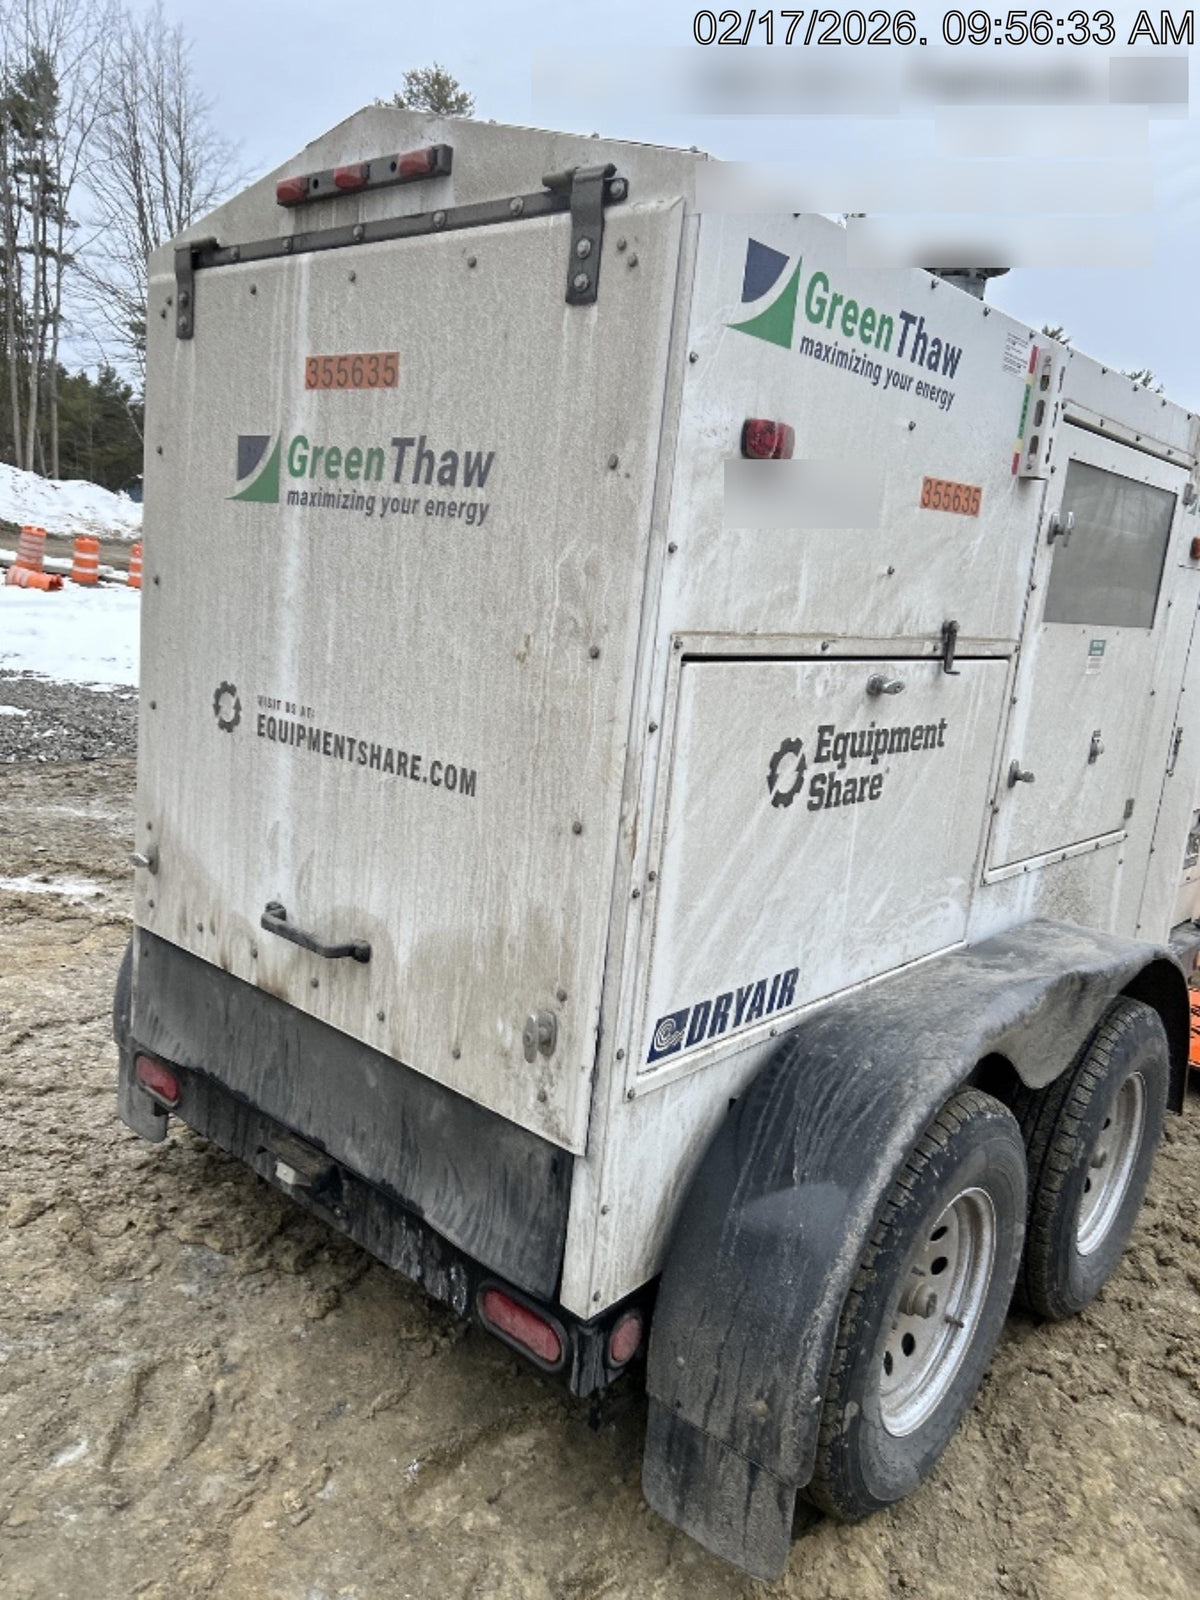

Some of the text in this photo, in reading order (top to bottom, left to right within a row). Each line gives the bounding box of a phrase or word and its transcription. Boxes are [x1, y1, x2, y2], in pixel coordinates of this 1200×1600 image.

[308, 355, 397, 387] 355635
[799, 335, 956, 412] maximizing your energy
[287, 487, 490, 527] maximizing your energy
[922, 479, 982, 516] 355635
[257, 695, 281, 710] VISIT
[256, 713, 477, 797] EQUIPMENTSHARE.COM
[814, 717, 948, 769] Equipment
[807, 771, 883, 811] Share
[684, 967, 800, 1048] DRYAIR
